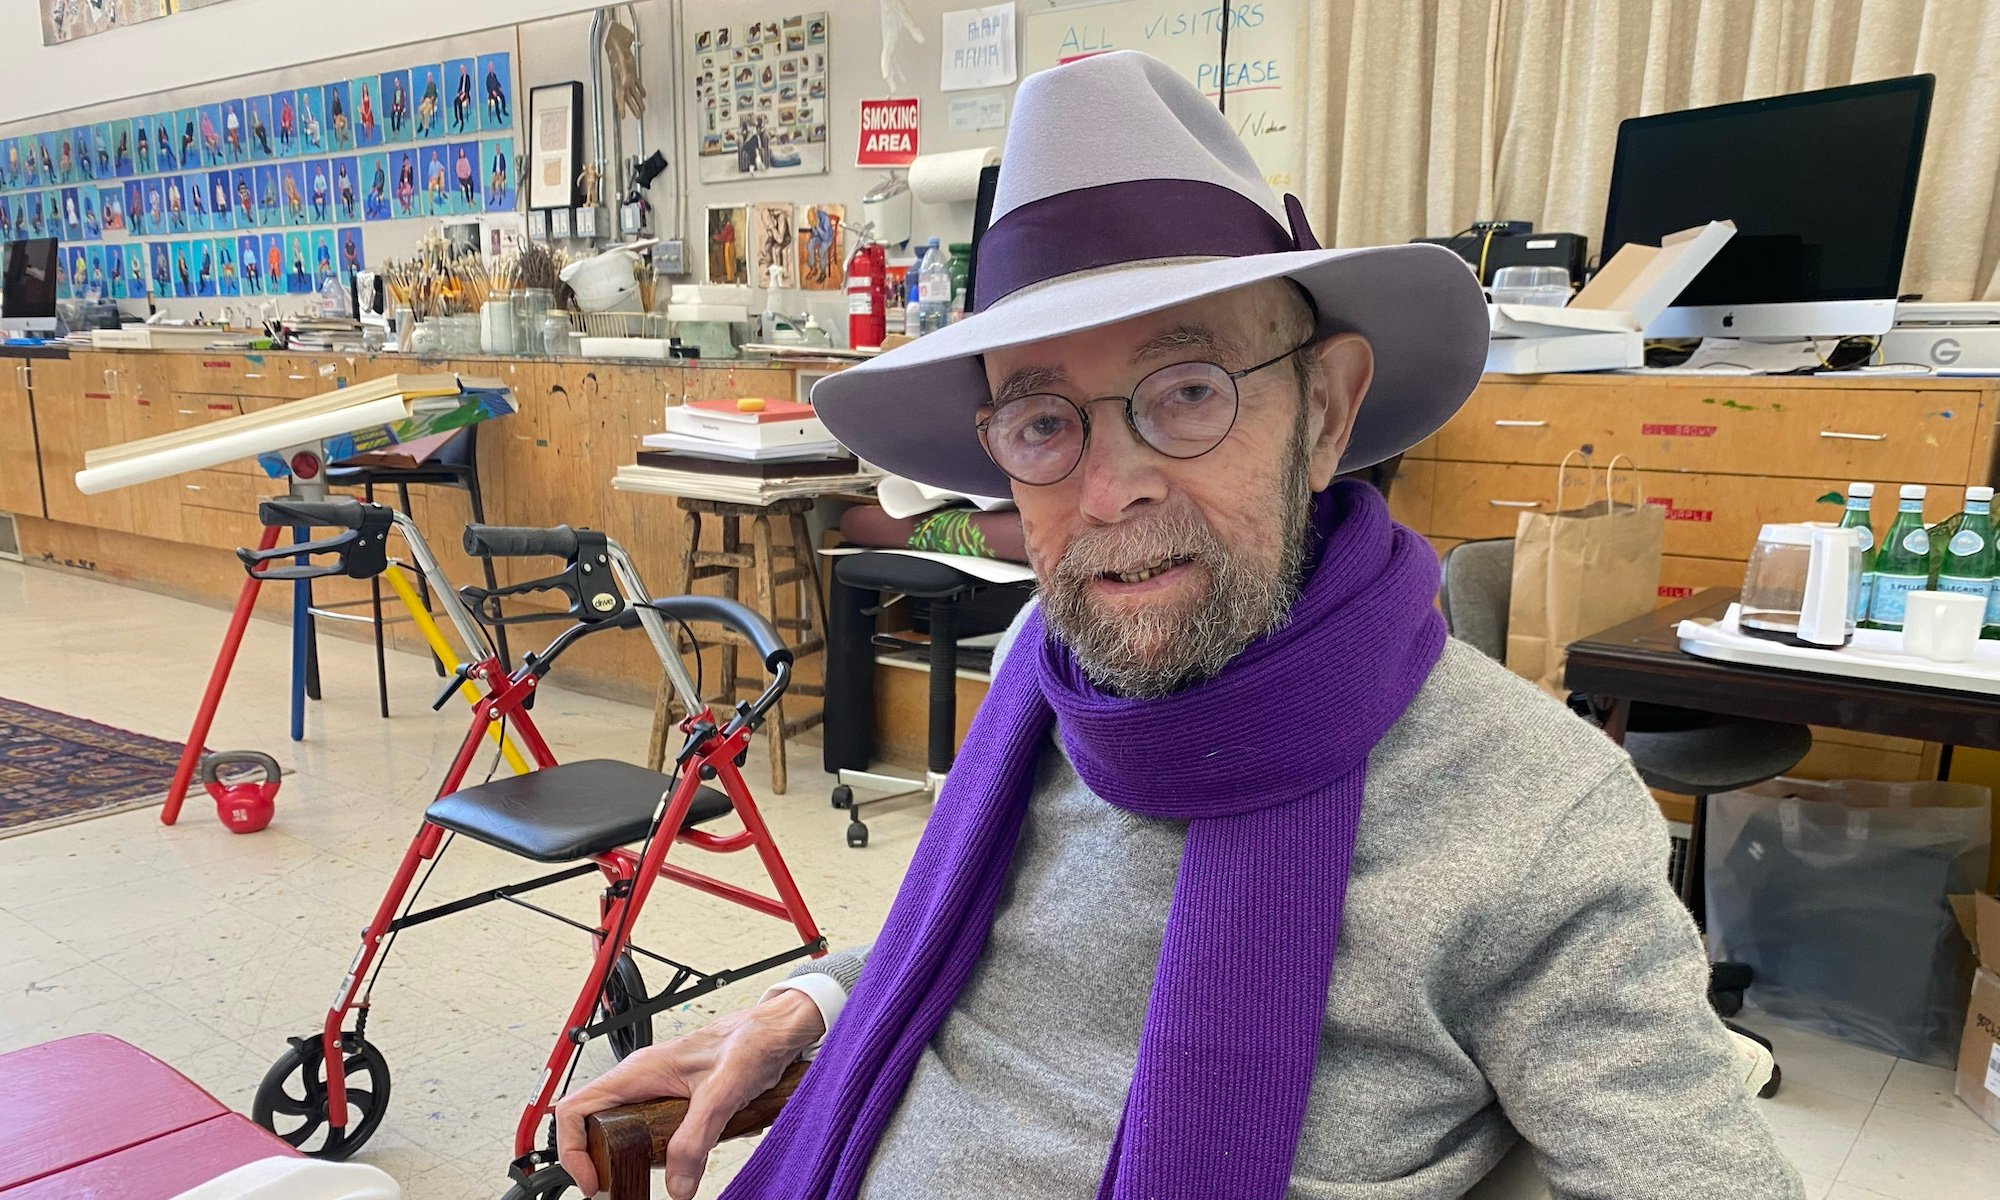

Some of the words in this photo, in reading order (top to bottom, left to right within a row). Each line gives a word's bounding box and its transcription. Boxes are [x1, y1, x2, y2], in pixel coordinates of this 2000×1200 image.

[1059, 25, 1113, 54] ALL
[1145, 4, 1264, 40] VISITORS
[1197, 60, 1280, 89] PLEASE
[863, 105, 917, 130] SMOKING
[866, 133, 911, 152] AREA
